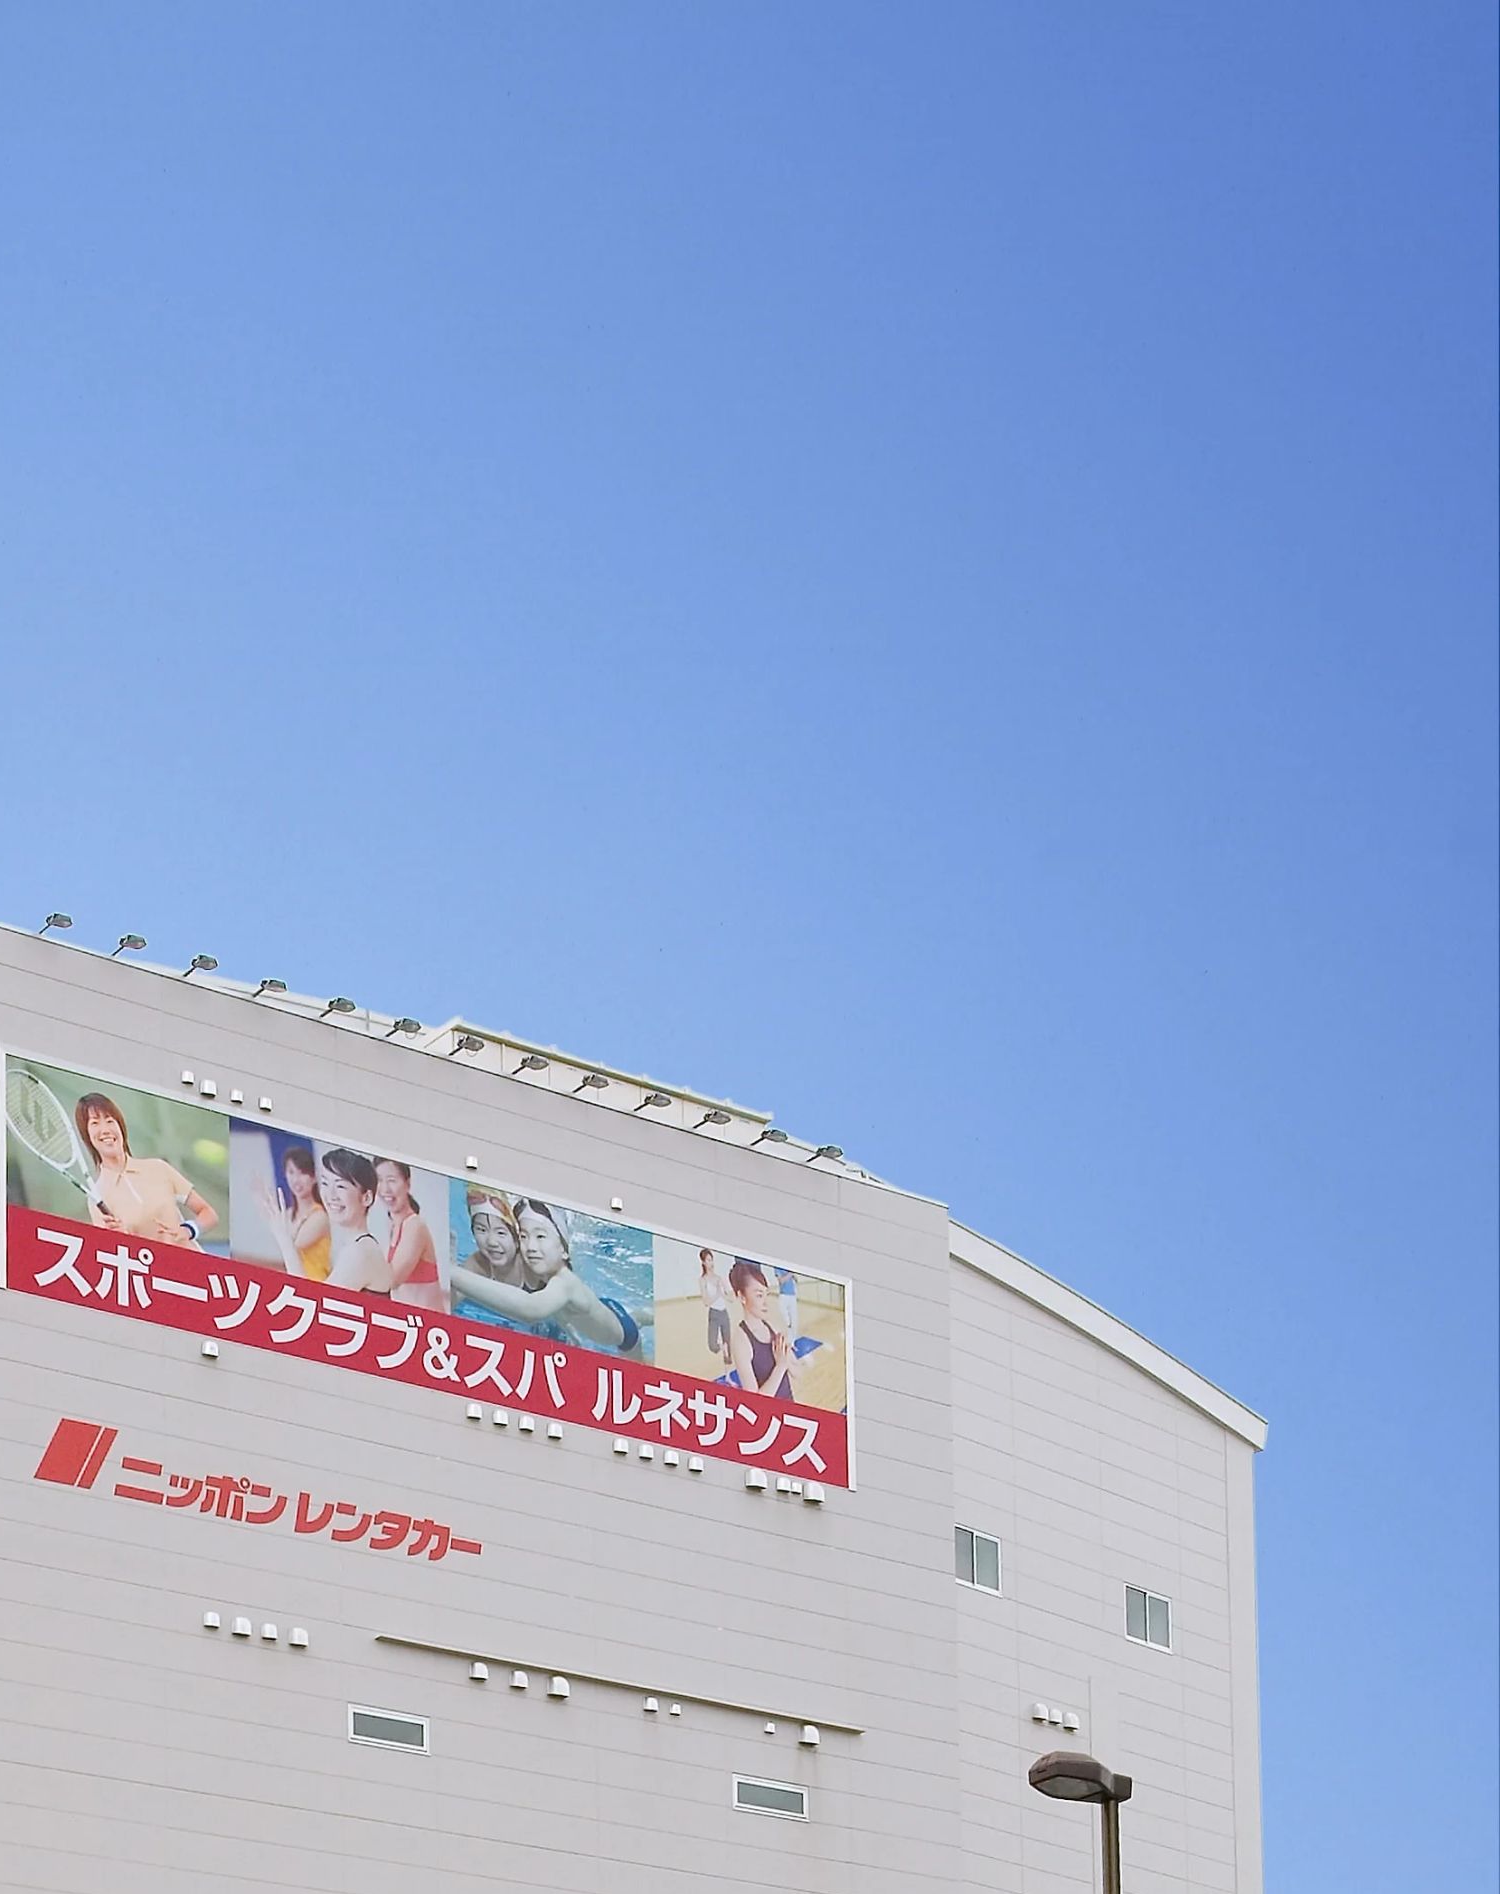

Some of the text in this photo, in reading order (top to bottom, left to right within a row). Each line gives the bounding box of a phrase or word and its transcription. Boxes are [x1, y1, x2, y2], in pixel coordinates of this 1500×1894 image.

[590, 1366, 828, 1474] ルネサンス
